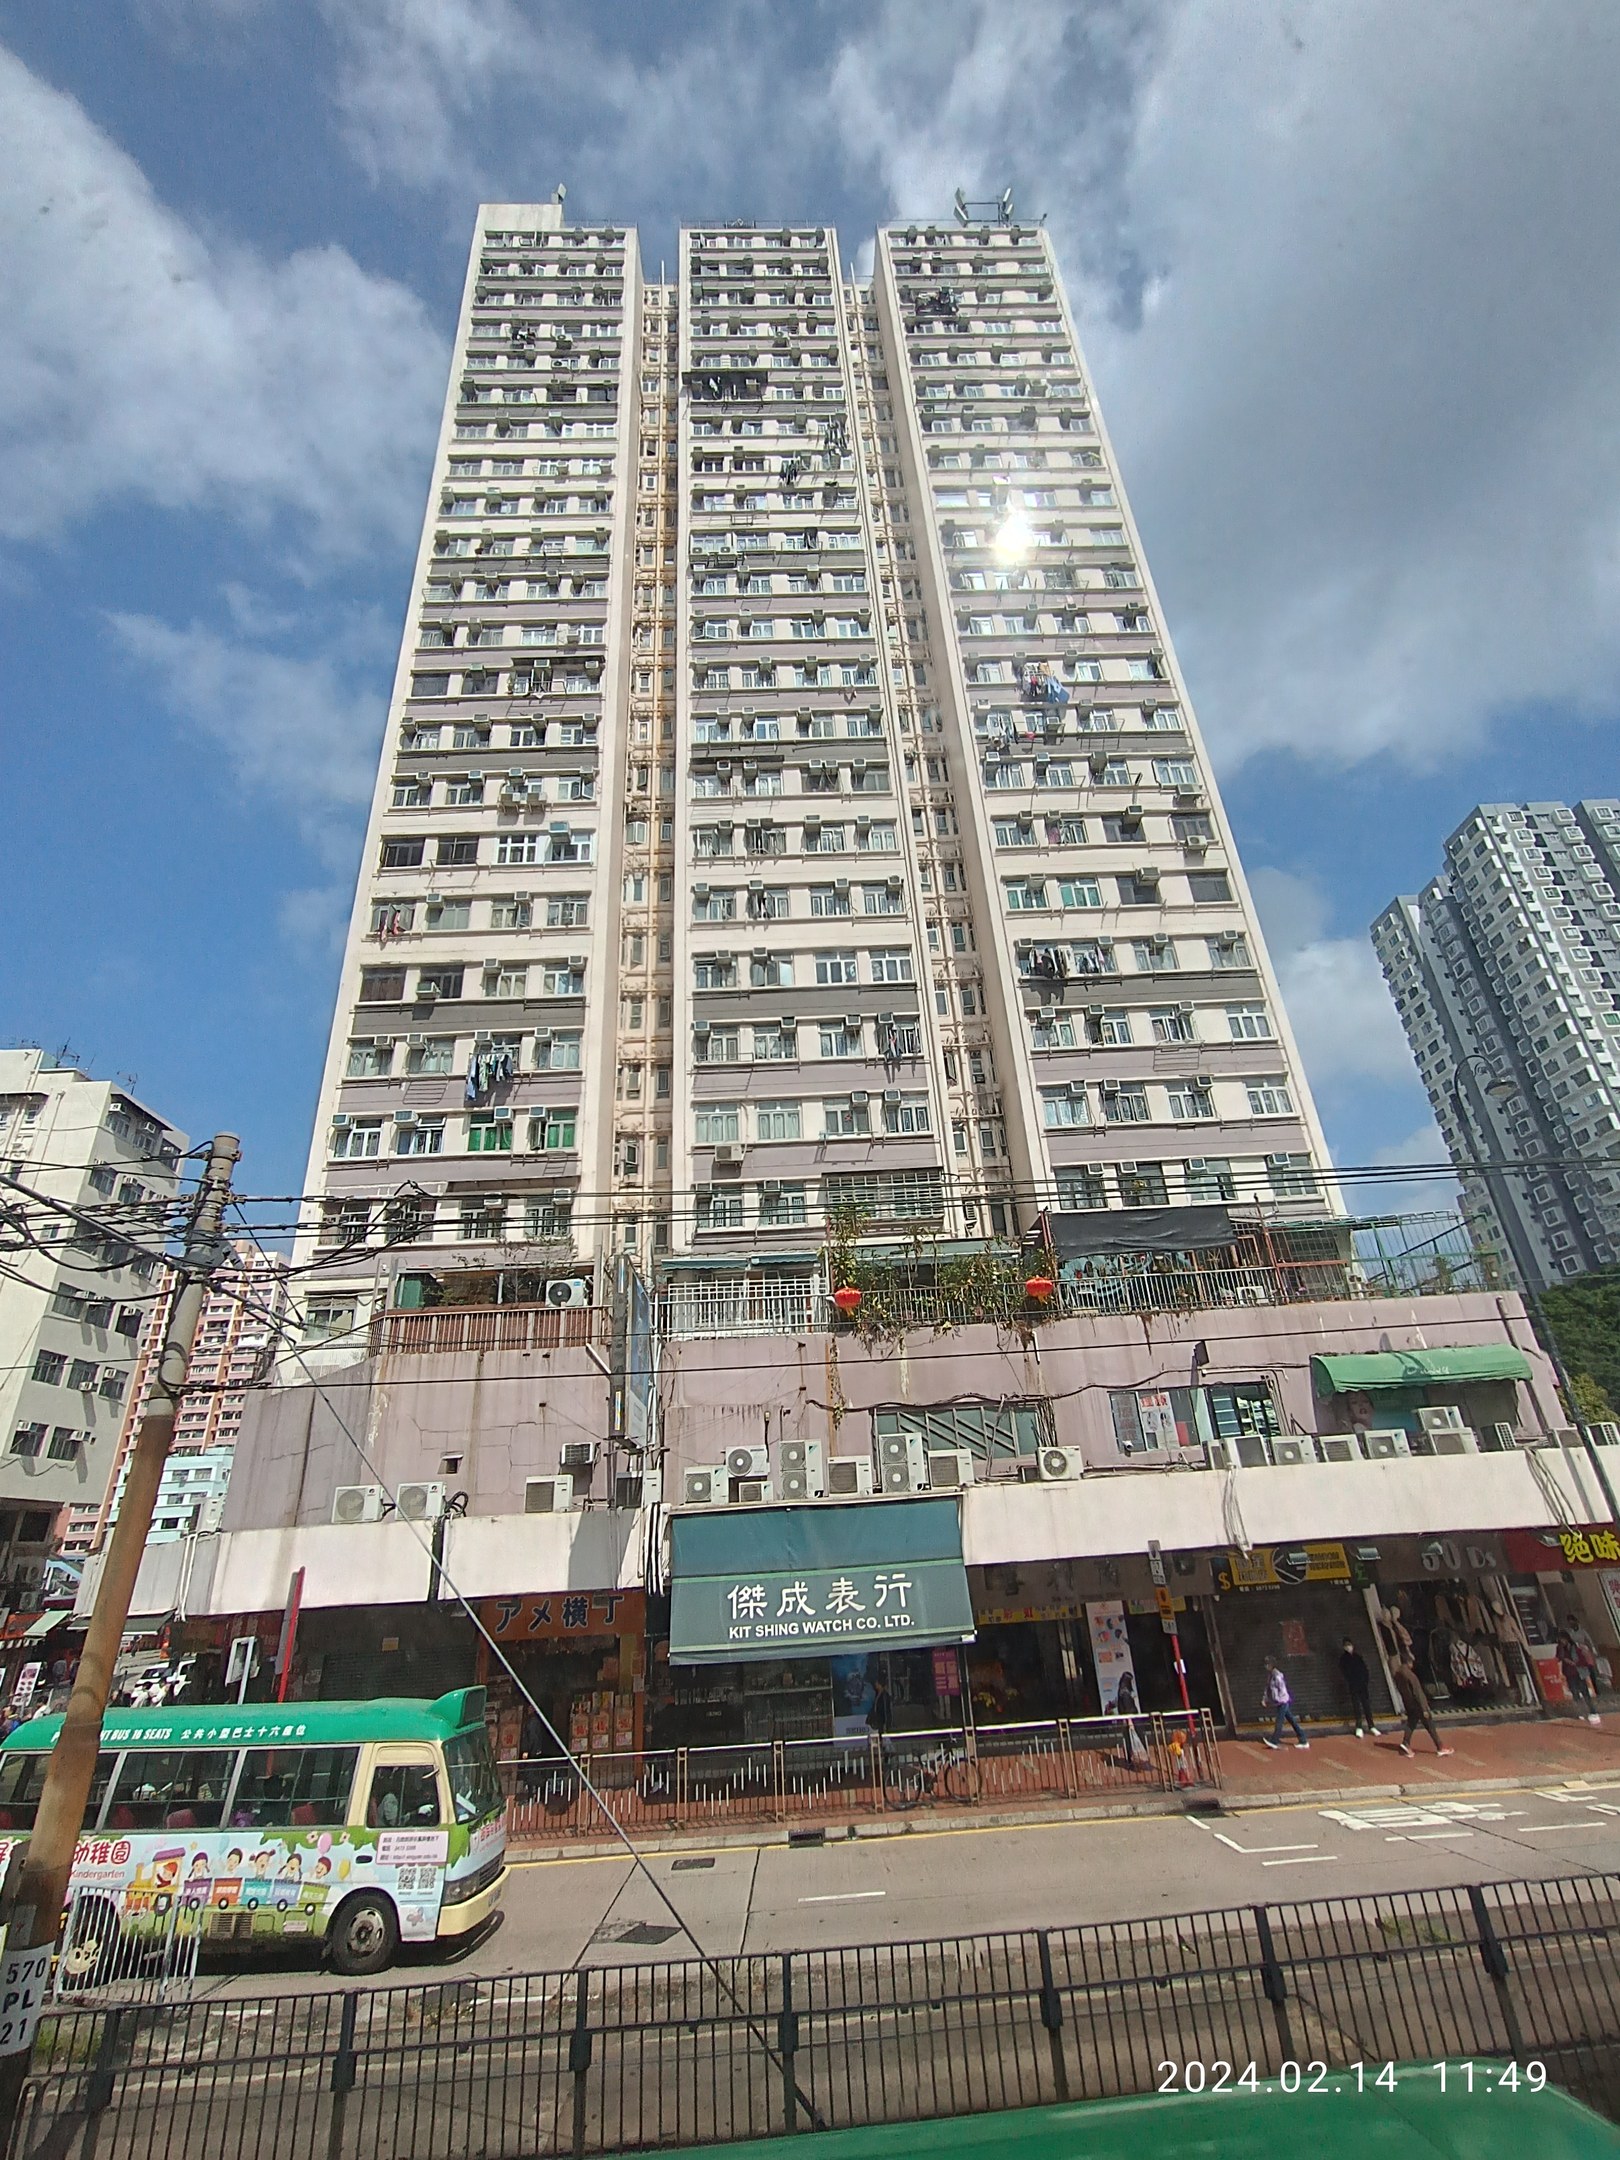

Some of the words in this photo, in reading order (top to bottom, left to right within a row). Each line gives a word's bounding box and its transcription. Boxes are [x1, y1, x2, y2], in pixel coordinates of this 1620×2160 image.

[727, 1573, 912, 1620] 傑成表行
[496, 1593, 624, 1633] アメ横丁
[729, 1626, 752, 1639] KIT
[755, 1622, 799, 1637] SHING
[802, 1619, 853, 1634] WATCH
[856, 1617, 881, 1629] CO.
[885, 1614, 915, 1628] LTD.
[111, 1728, 131, 1740] BUS
[143, 1727, 172, 1740] SEATS
[72, 1841, 131, 1865] 幼稚園
[6, 1956, 46, 1984] 570
[2, 1989, 35, 2014] PL
[0, 2018, 28, 2045] 21
